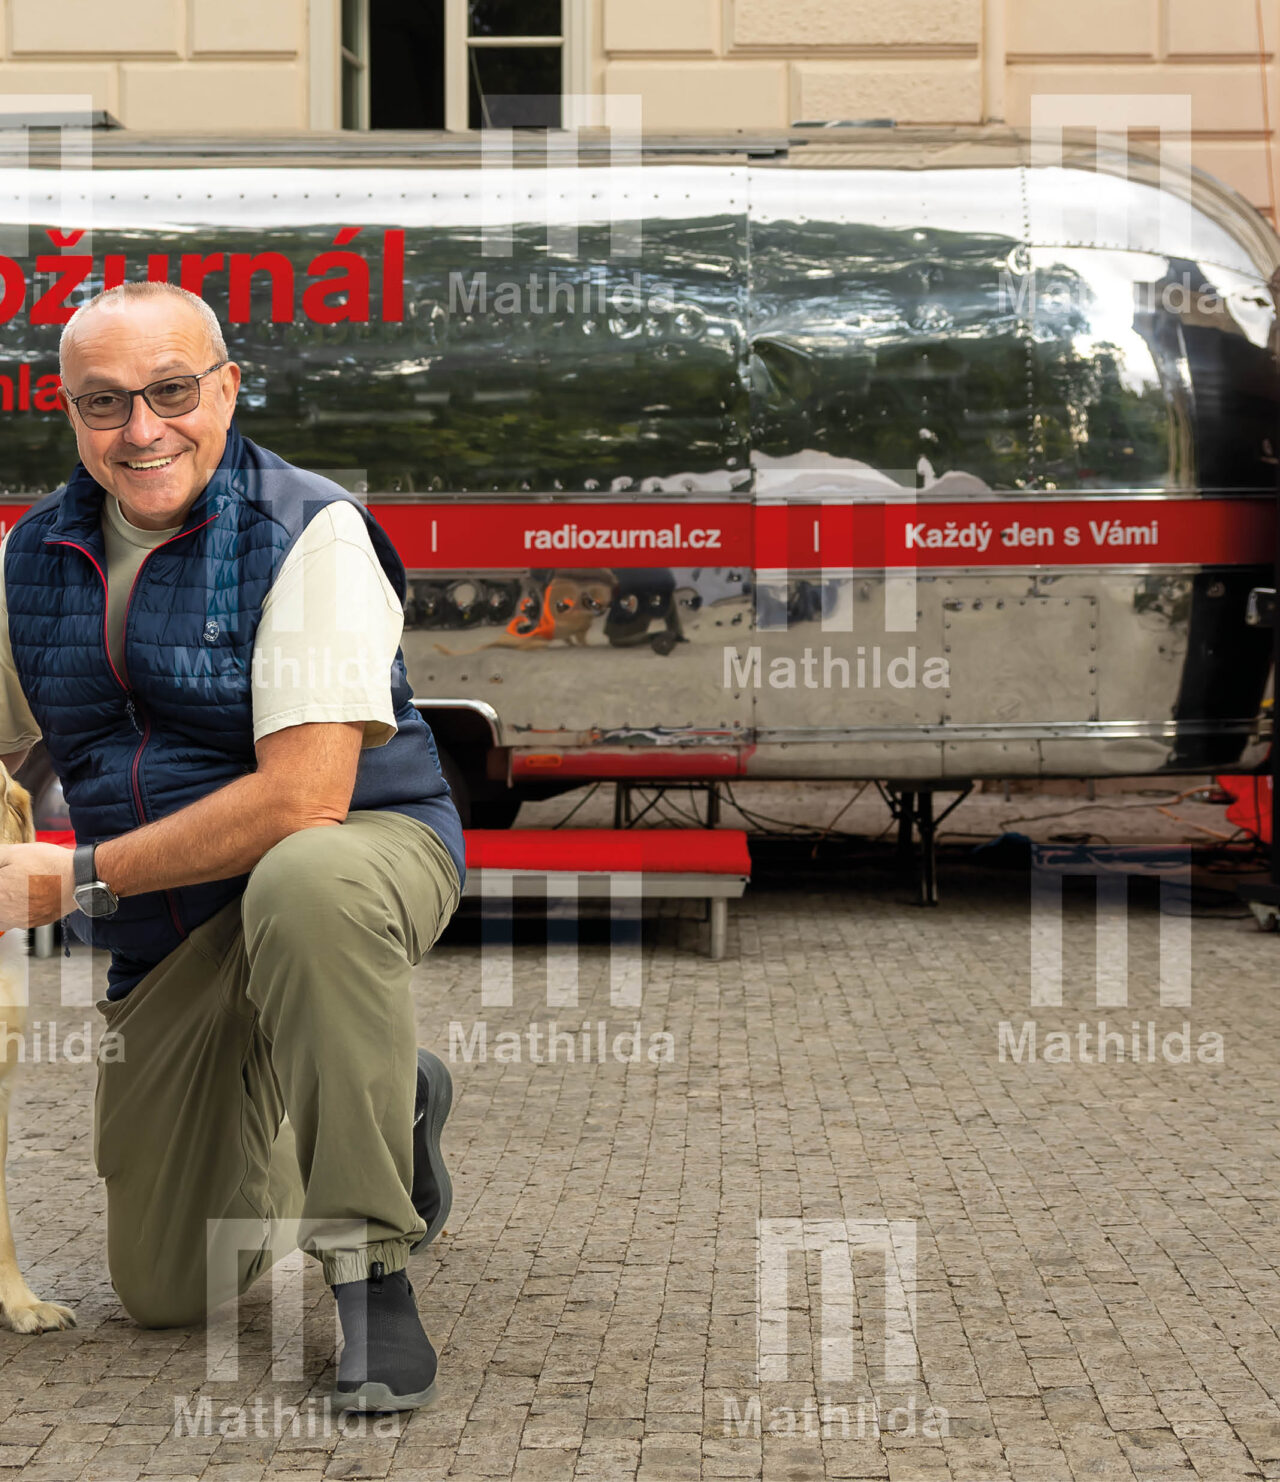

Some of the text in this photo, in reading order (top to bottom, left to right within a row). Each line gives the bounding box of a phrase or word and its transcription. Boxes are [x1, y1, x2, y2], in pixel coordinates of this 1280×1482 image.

[523, 523, 721, 550] radiozurnal.cz
[905, 519, 1159, 552] Každý den s Vámi
